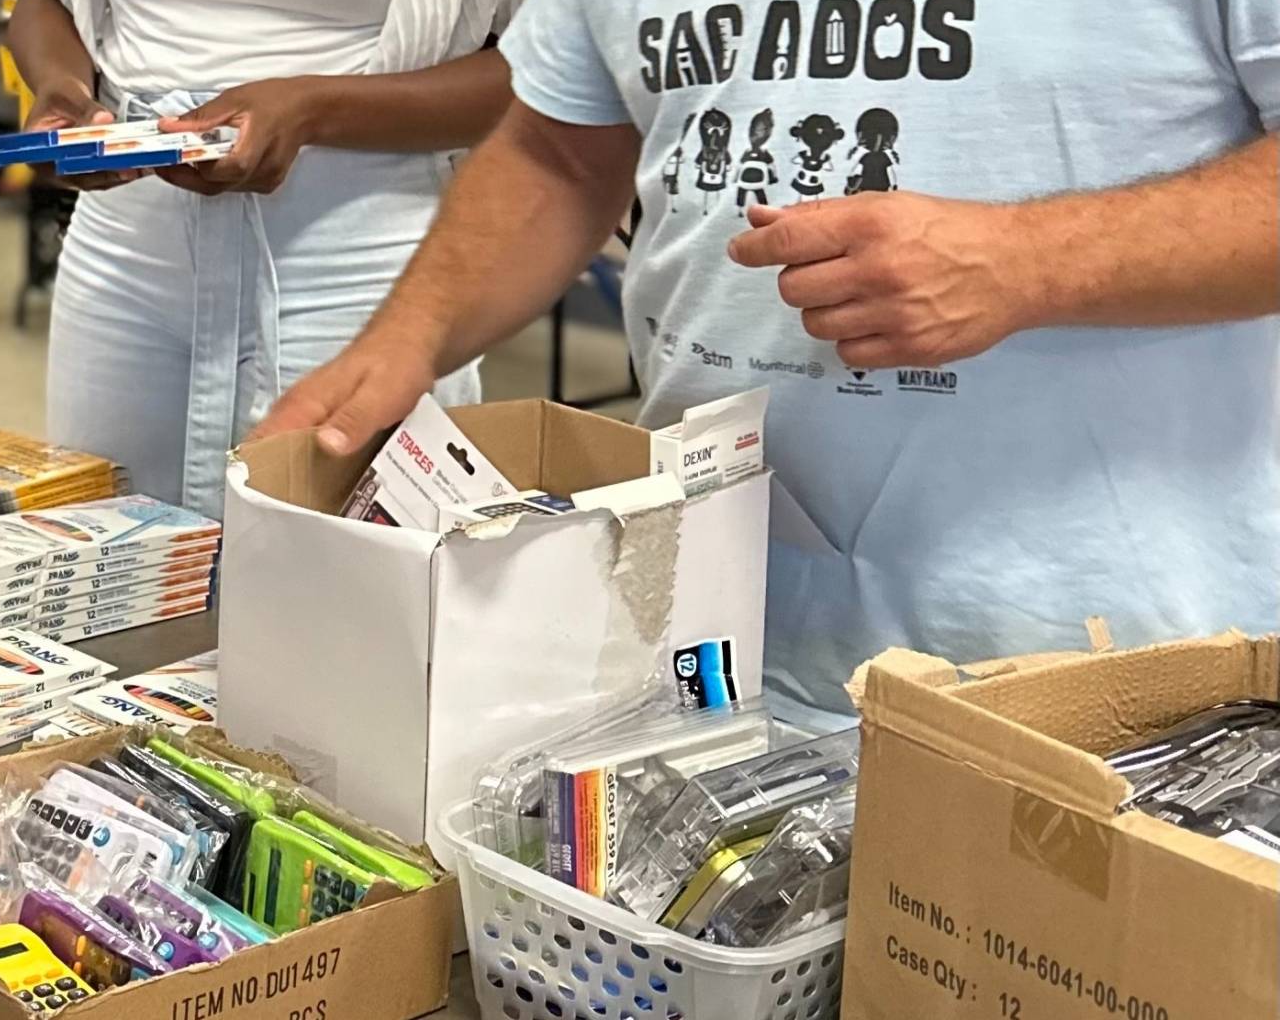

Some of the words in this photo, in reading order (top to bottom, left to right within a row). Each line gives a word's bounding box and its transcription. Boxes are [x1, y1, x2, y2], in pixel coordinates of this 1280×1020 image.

[638, 3, 742, 94] SAC
[702, 351, 732, 369] stm
[897, 370, 958, 389] MAYRAND
[397, 430, 435, 474] STAPLES
[684, 447, 712, 467] DEXIN
[53, 551, 80, 563] PRANG
[100, 546, 110, 556] 12
[48, 568, 76, 580] PRANG
[96, 563, 106, 573] 12
[43, 585, 71, 597] PRANG
[91, 579, 101, 589] 12
[41, 602, 69, 614] PRANG
[89, 595, 98, 605] 12
[38, 617, 66, 630] PRANG
[86, 610, 96, 619] 12
[83, 625, 93, 635] 12
[2, 635, 68, 666] PRANG
[680, 655, 694, 673] 12
[36, 683, 45, 693] 12
[44, 700, 53, 710] 12
[607, 773, 616, 827] GEOSET
[608, 834, 616, 858] 559
[562, 844, 572, 872] GEOSET
[888, 881, 925, 921] Item
[930, 902, 960, 939] No.
[173, 986, 224, 1020] ITEM
[266, 947, 341, 999] DU1497
[886, 935, 929, 976] Case
[933, 960, 967, 1000] Qty
[999, 992, 1022, 1020] 12
